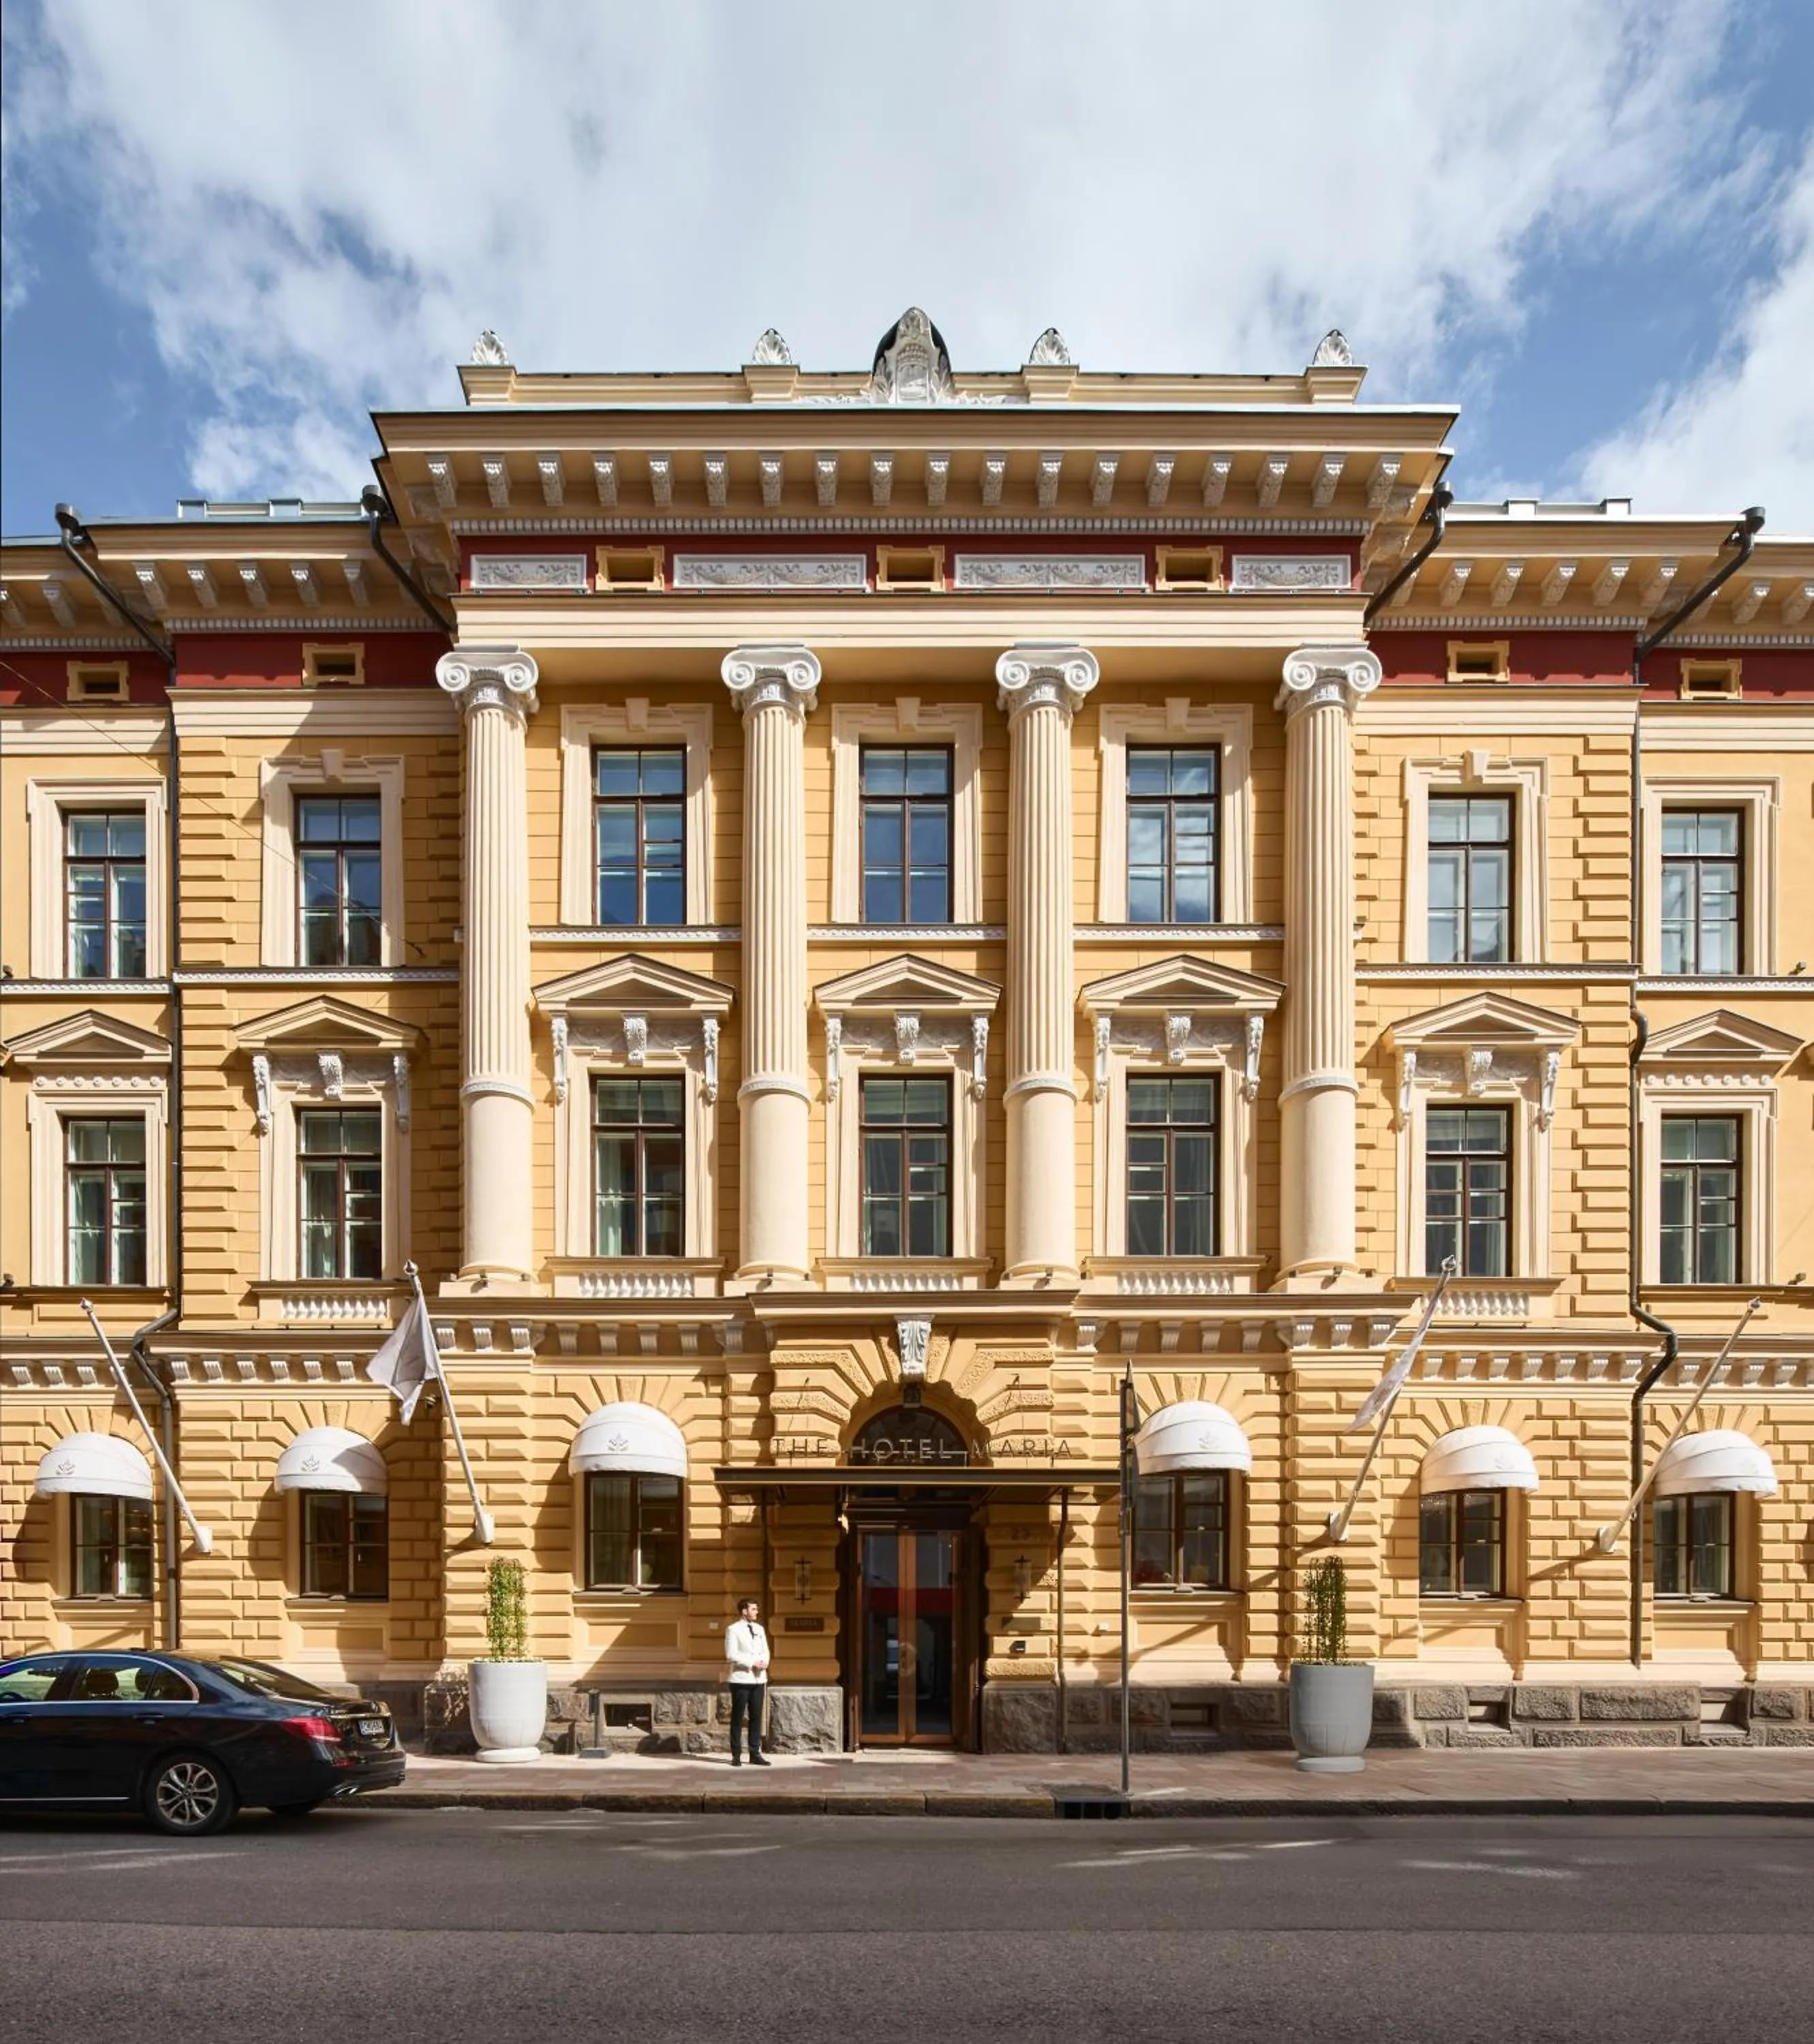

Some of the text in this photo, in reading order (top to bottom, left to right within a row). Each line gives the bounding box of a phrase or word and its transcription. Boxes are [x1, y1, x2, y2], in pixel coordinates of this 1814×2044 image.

[773, 1438, 1072, 1459] THE HOTEL MARIA
